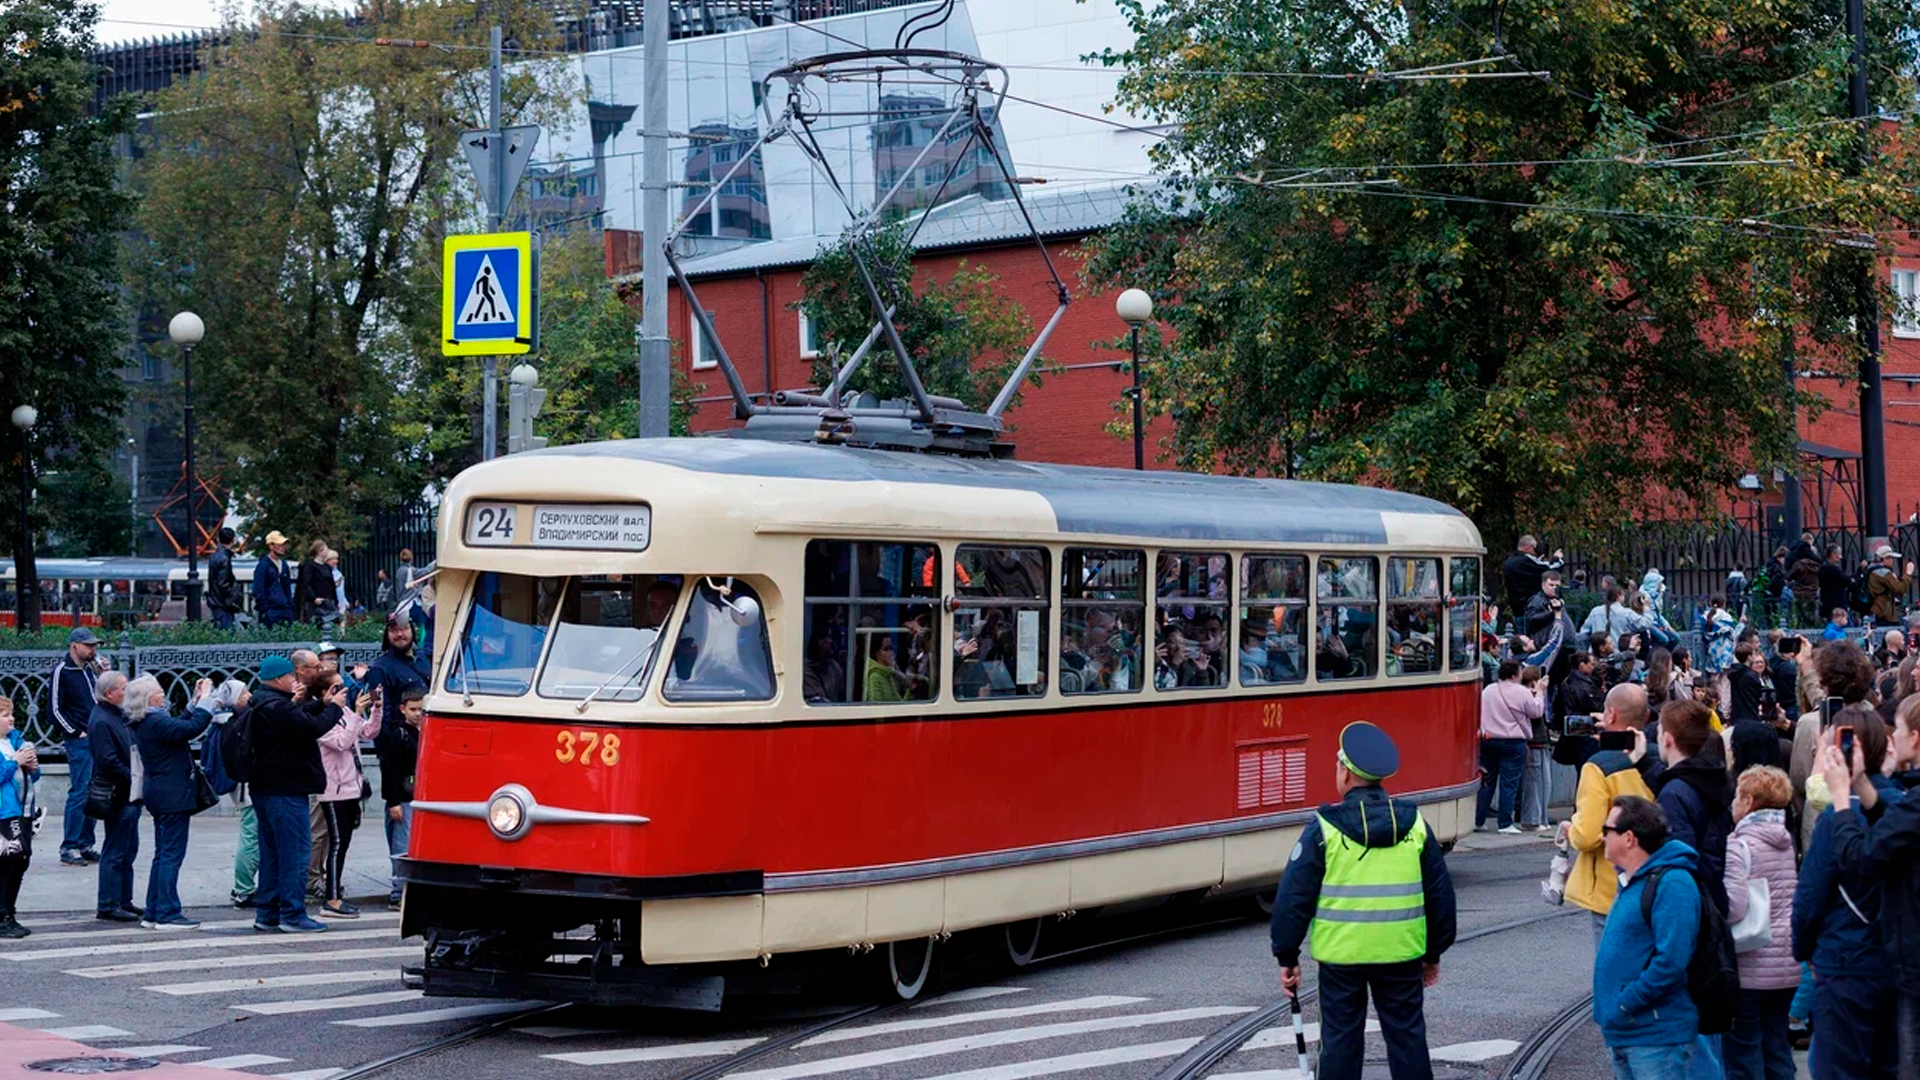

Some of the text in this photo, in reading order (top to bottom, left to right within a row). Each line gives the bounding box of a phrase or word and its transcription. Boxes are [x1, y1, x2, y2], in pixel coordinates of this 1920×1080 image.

[478, 508, 513, 537] 24
[540, 511, 620, 526] СЕРПУХОВСКИЙ
[538, 527, 620, 541] ВЛАДИМИРСКИЙ
[1262, 703, 1283, 728] 378
[555, 730, 621, 767] 378
